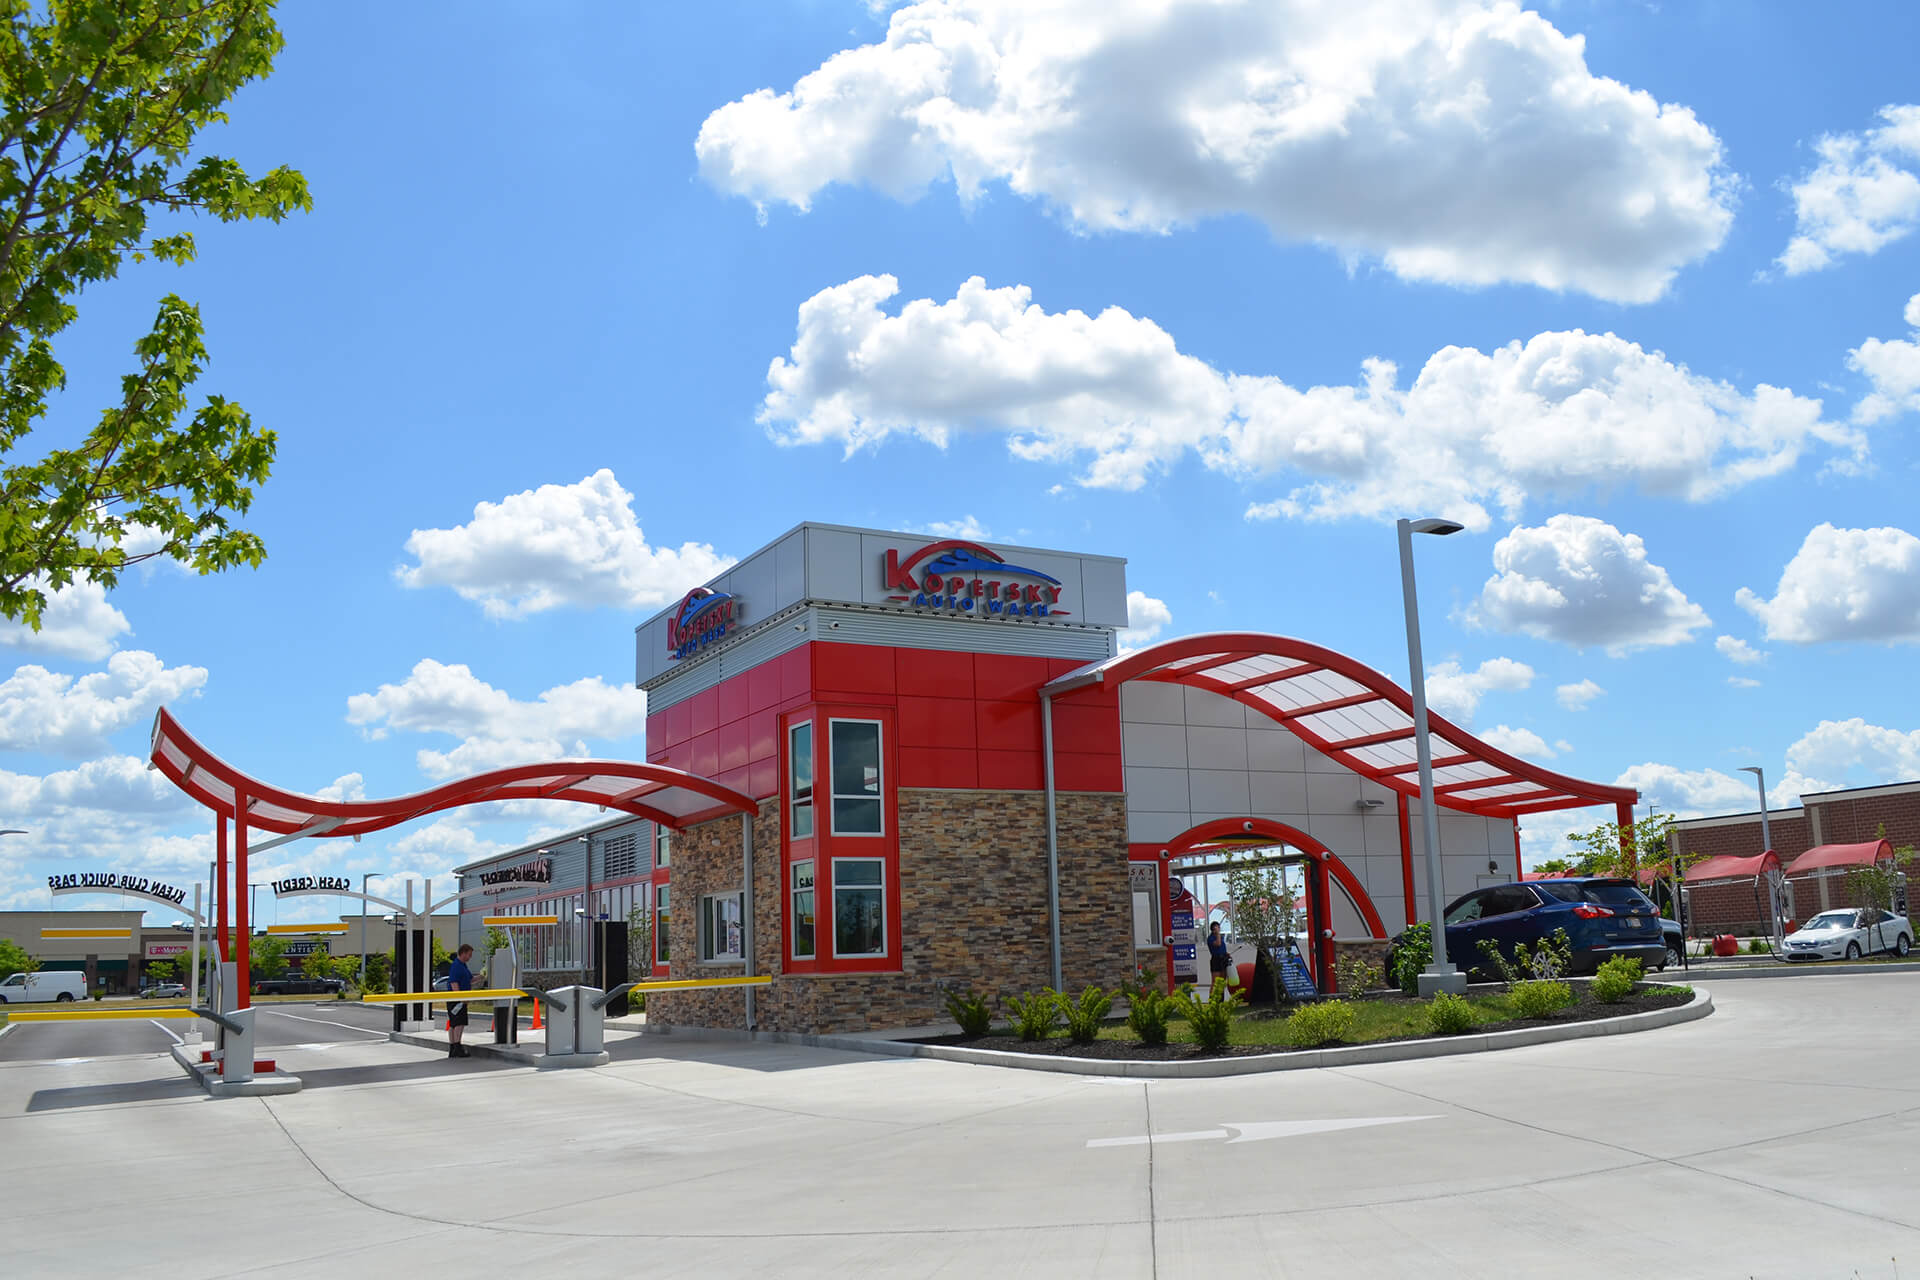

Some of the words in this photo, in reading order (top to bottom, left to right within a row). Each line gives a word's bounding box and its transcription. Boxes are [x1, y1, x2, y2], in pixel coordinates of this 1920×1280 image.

[887, 540, 1062, 603] KOPETSKY
[667, 588, 732, 651] KOPETSKY
[916, 592, 974, 610] AUTO
[988, 599, 1048, 617] WASH
